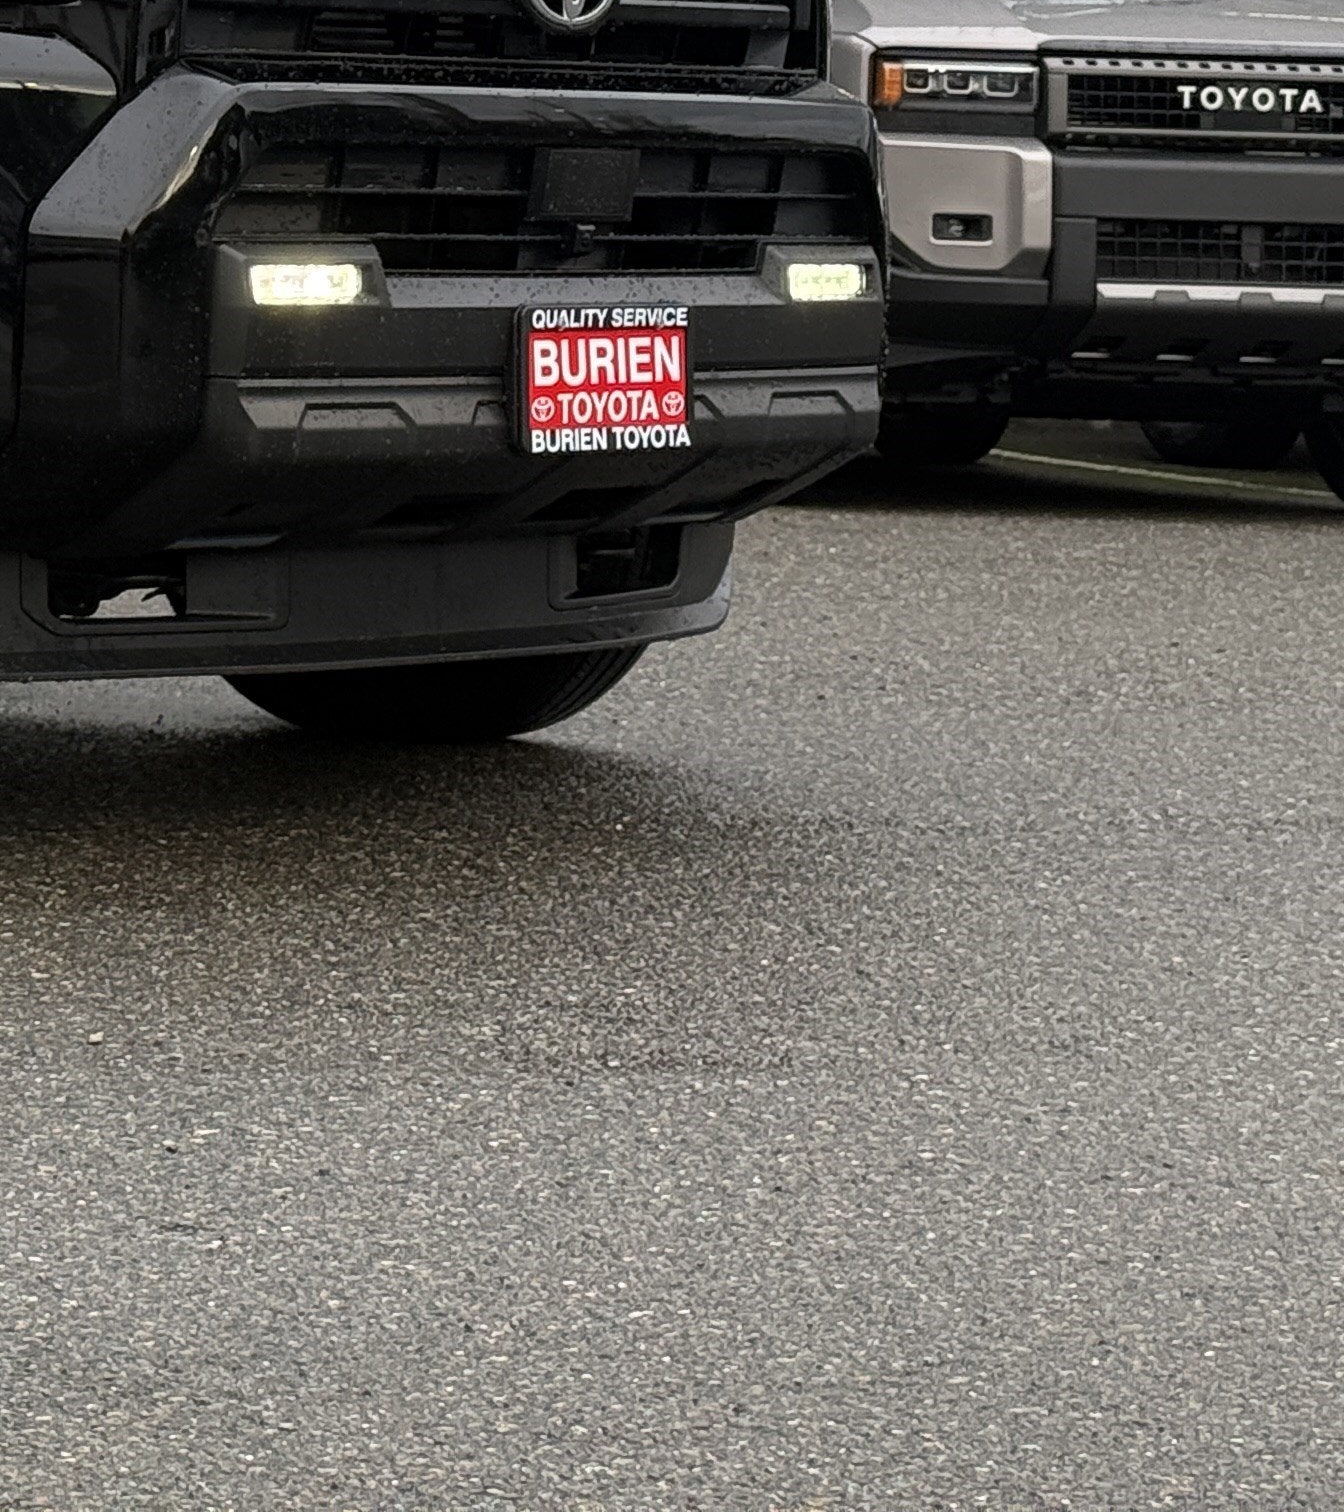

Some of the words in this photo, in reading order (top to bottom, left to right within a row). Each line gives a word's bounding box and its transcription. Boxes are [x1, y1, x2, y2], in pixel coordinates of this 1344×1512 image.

[1177, 85, 1324, 114] TOYOTA
[531, 307, 610, 330] QUALITY
[611, 307, 689, 327] SERVICE
[532, 335, 682, 388] BURIEN
[556, 389, 661, 425] TOYOTA
[531, 426, 609, 454] BURIEN
[611, 423, 693, 450] TOYOTA
